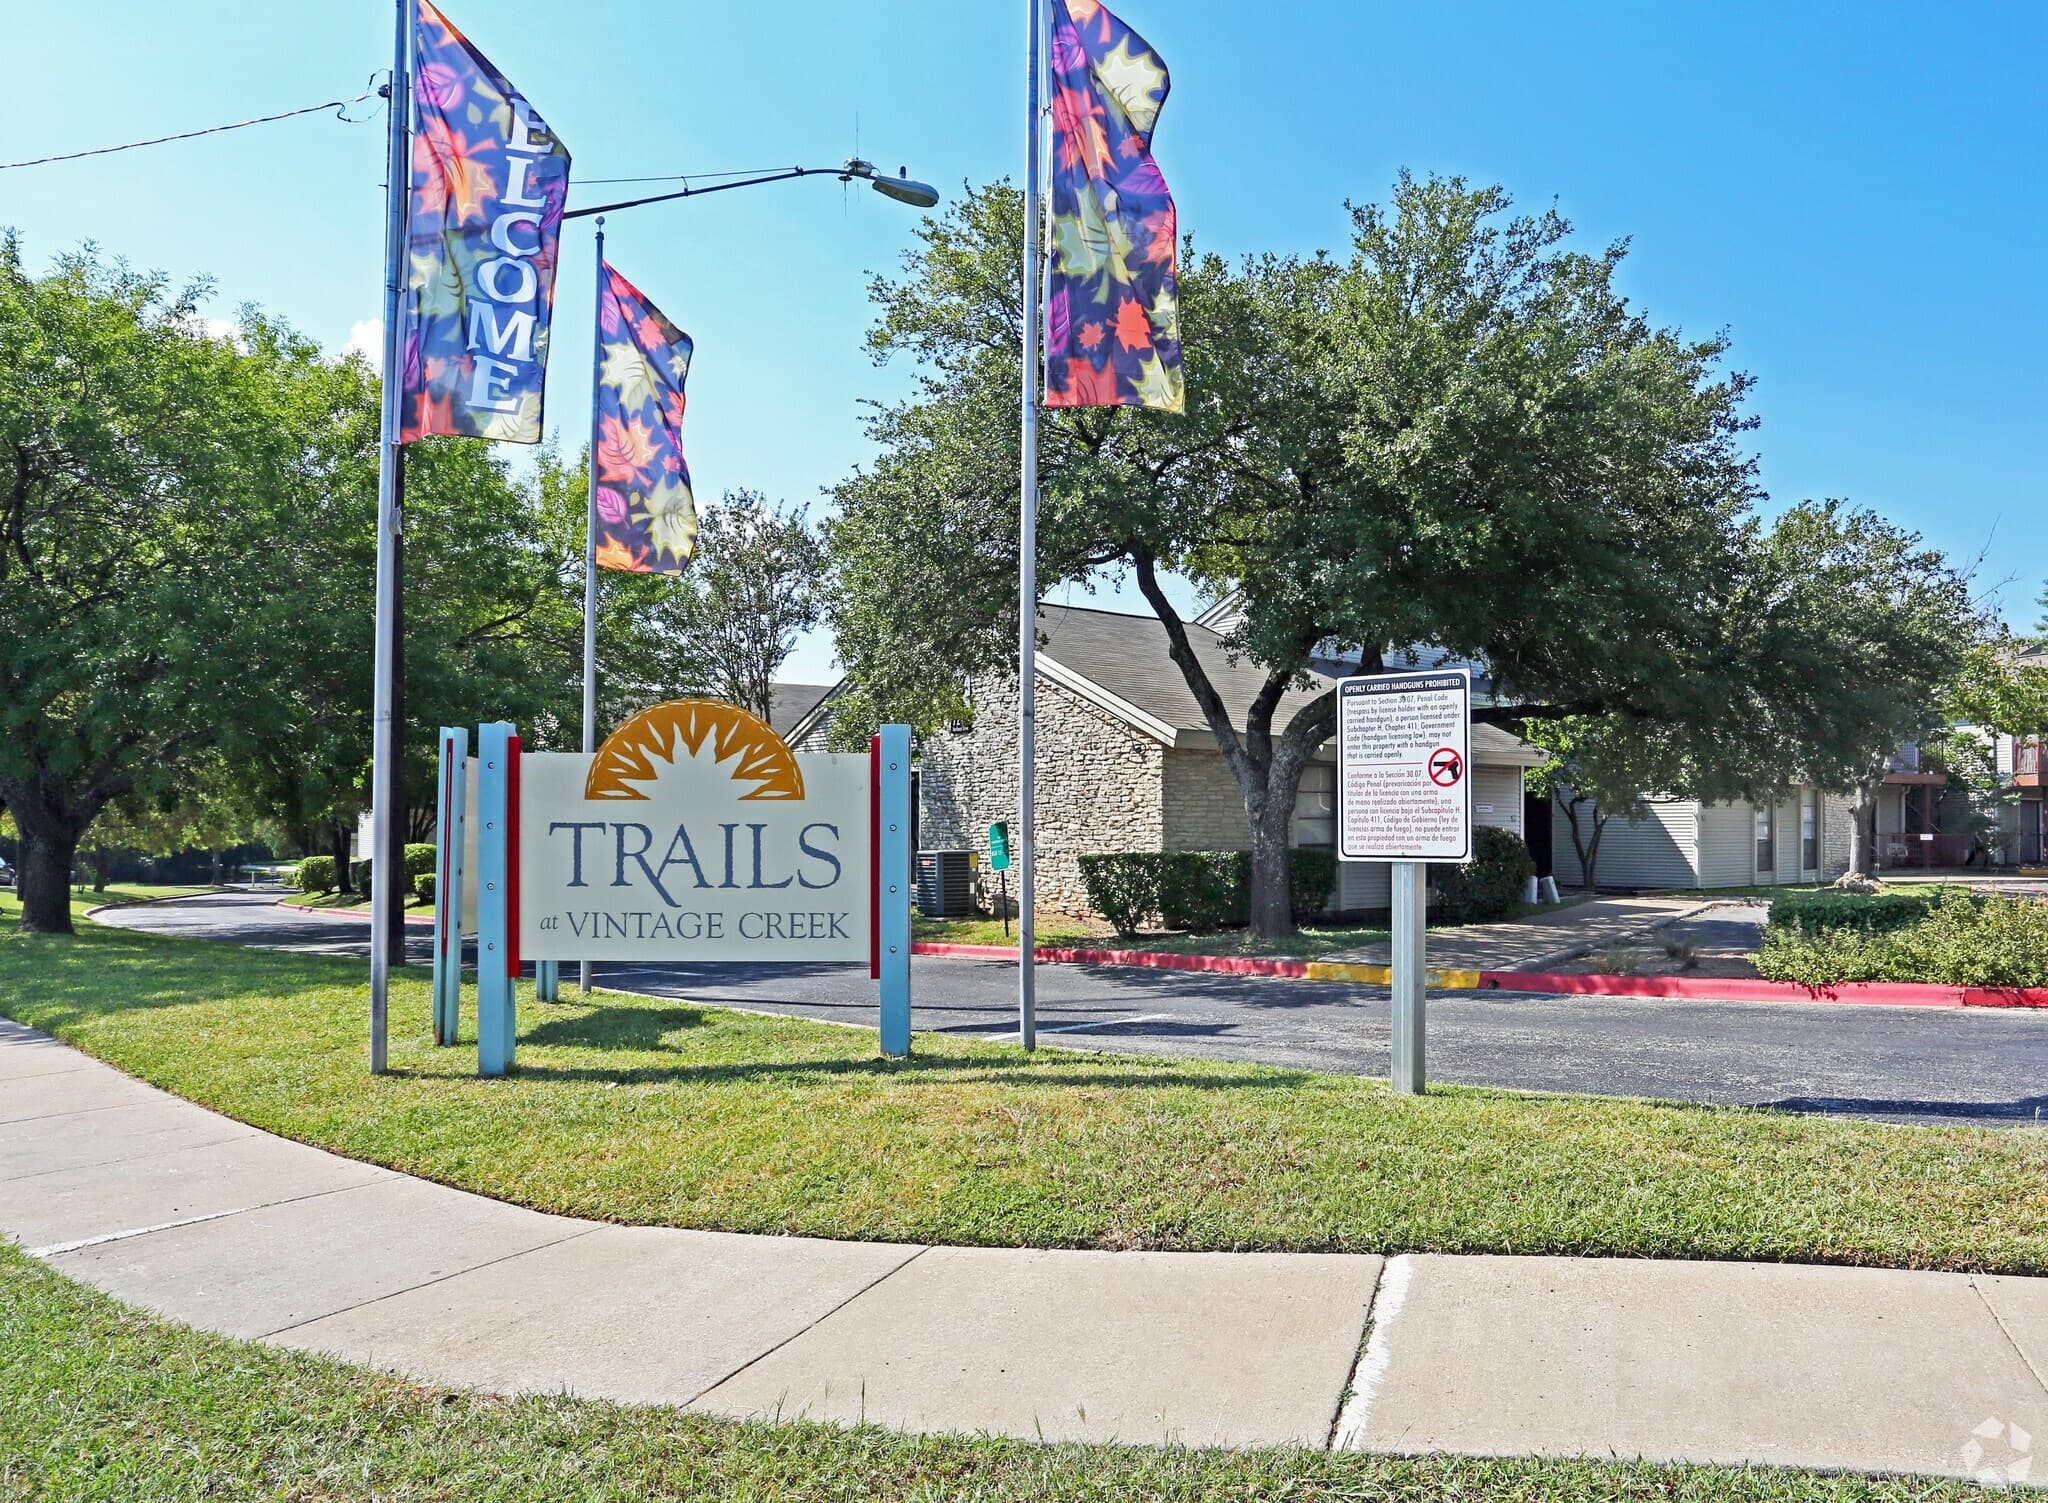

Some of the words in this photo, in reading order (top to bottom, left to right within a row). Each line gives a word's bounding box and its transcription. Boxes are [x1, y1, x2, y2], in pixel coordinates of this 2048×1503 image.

[466, 96, 555, 412] ELCOME
[1345, 685, 1365, 693] OPENLY
[1366, 683, 1390, 692] CARRIED
[1391, 681, 1424, 690] HANDGUNS
[1425, 679, 1460, 688] PROHIBITED
[1434, 693, 1448, 701] Code
[1347, 707, 1370, 716] (trespass
[1439, 703, 1458, 711] openly
[1347, 716, 1365, 724] carried
[1347, 725, 1376, 734] Subchapter
[1385, 723, 1406, 731] Chapter
[1421, 721, 1455, 729] Government
[1361, 732, 1387, 743] (handgun
[1388, 732, 1412, 740] licensing
[1347, 743, 1361, 751] enter
[1373, 742, 1395, 751] property
[1397, 740, 1408, 748] with
[1415, 740, 1439, 748] handgun
[1347, 751, 1358, 759] that
[1364, 750, 1383, 758] carried
[549, 822, 841, 908] TRAILS
[540, 915, 559, 930] at
[566, 911, 725, 939] VINTAGE
[739, 911, 851, 939] CREEK
